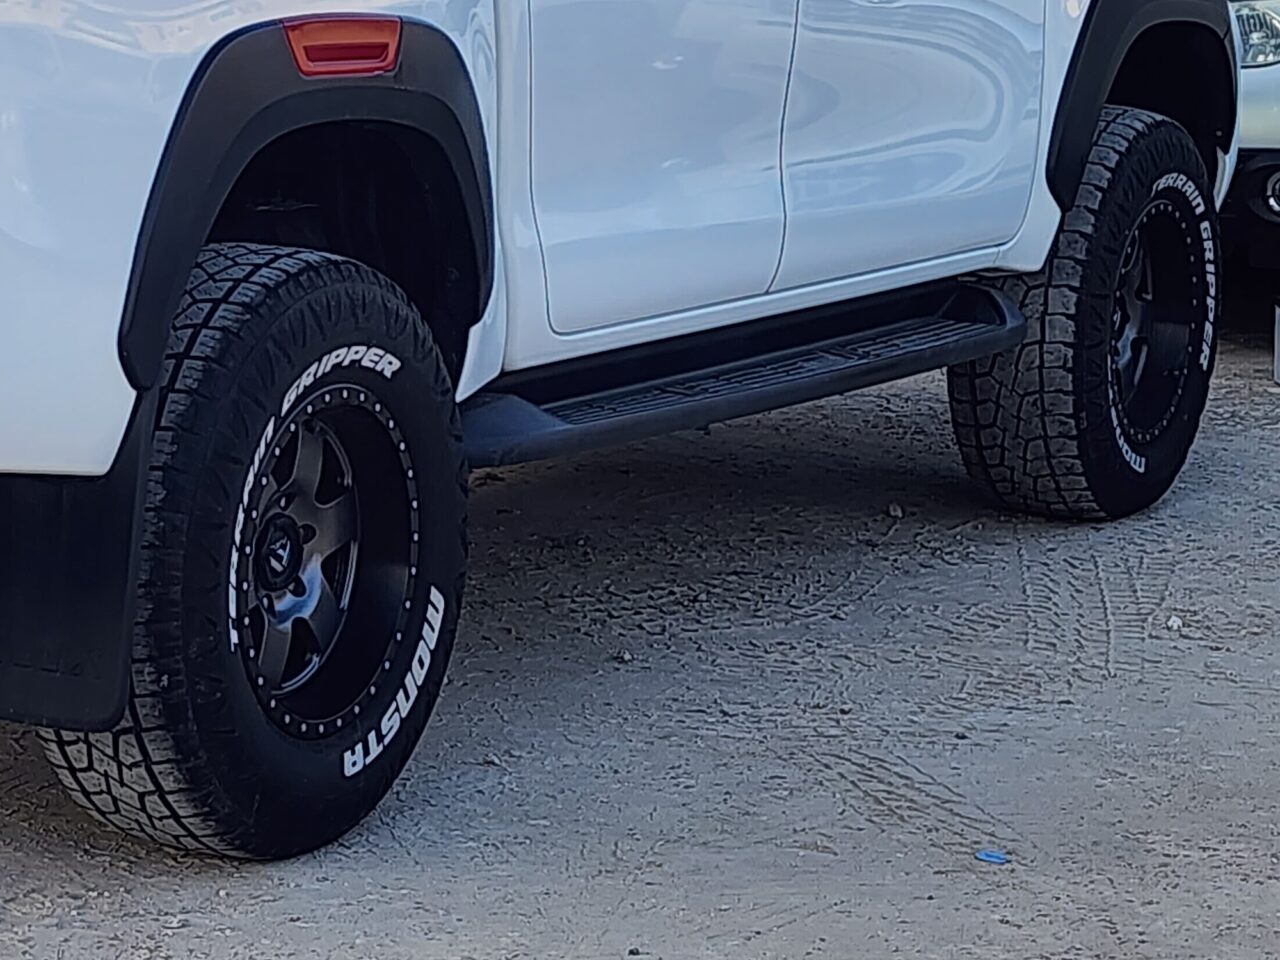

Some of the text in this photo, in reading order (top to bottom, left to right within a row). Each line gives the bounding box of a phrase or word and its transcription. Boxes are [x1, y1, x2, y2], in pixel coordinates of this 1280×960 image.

[1150, 172, 1217, 372] TERRAIN GRIPPER
[228, 344, 402, 654] TERRAIN GRIPPER
[343, 585, 445, 778] MONSTA
